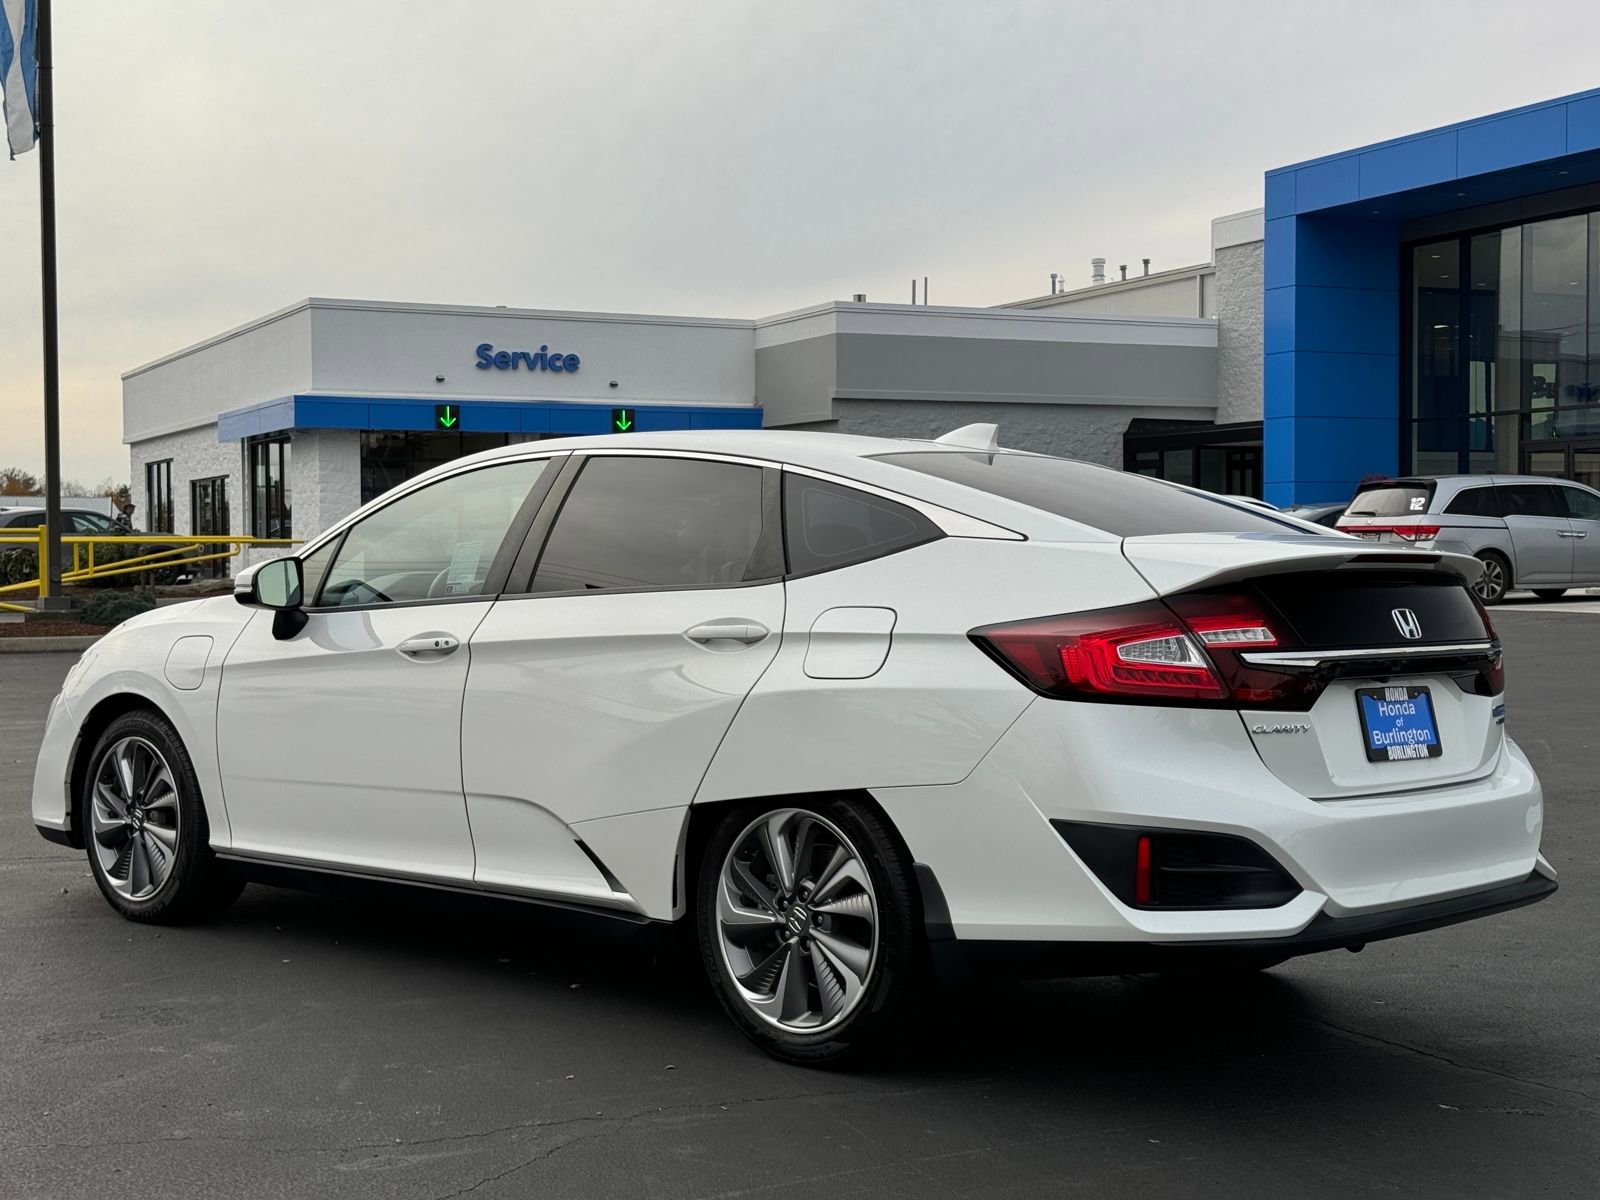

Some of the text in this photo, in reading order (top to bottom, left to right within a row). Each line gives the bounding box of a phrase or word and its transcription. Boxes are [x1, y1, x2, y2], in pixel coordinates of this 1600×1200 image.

[476, 343, 580, 372] Service
[1410, 497, 1426, 511] 12
[1385, 687, 1409, 702] HONDA
[1378, 701, 1416, 717] Honda
[1252, 724, 1311, 734] CLARITY
[1395, 717, 1404, 727] of
[1373, 728, 1432, 745] Burlington
[1387, 743, 1429, 760] BURLINGTON
